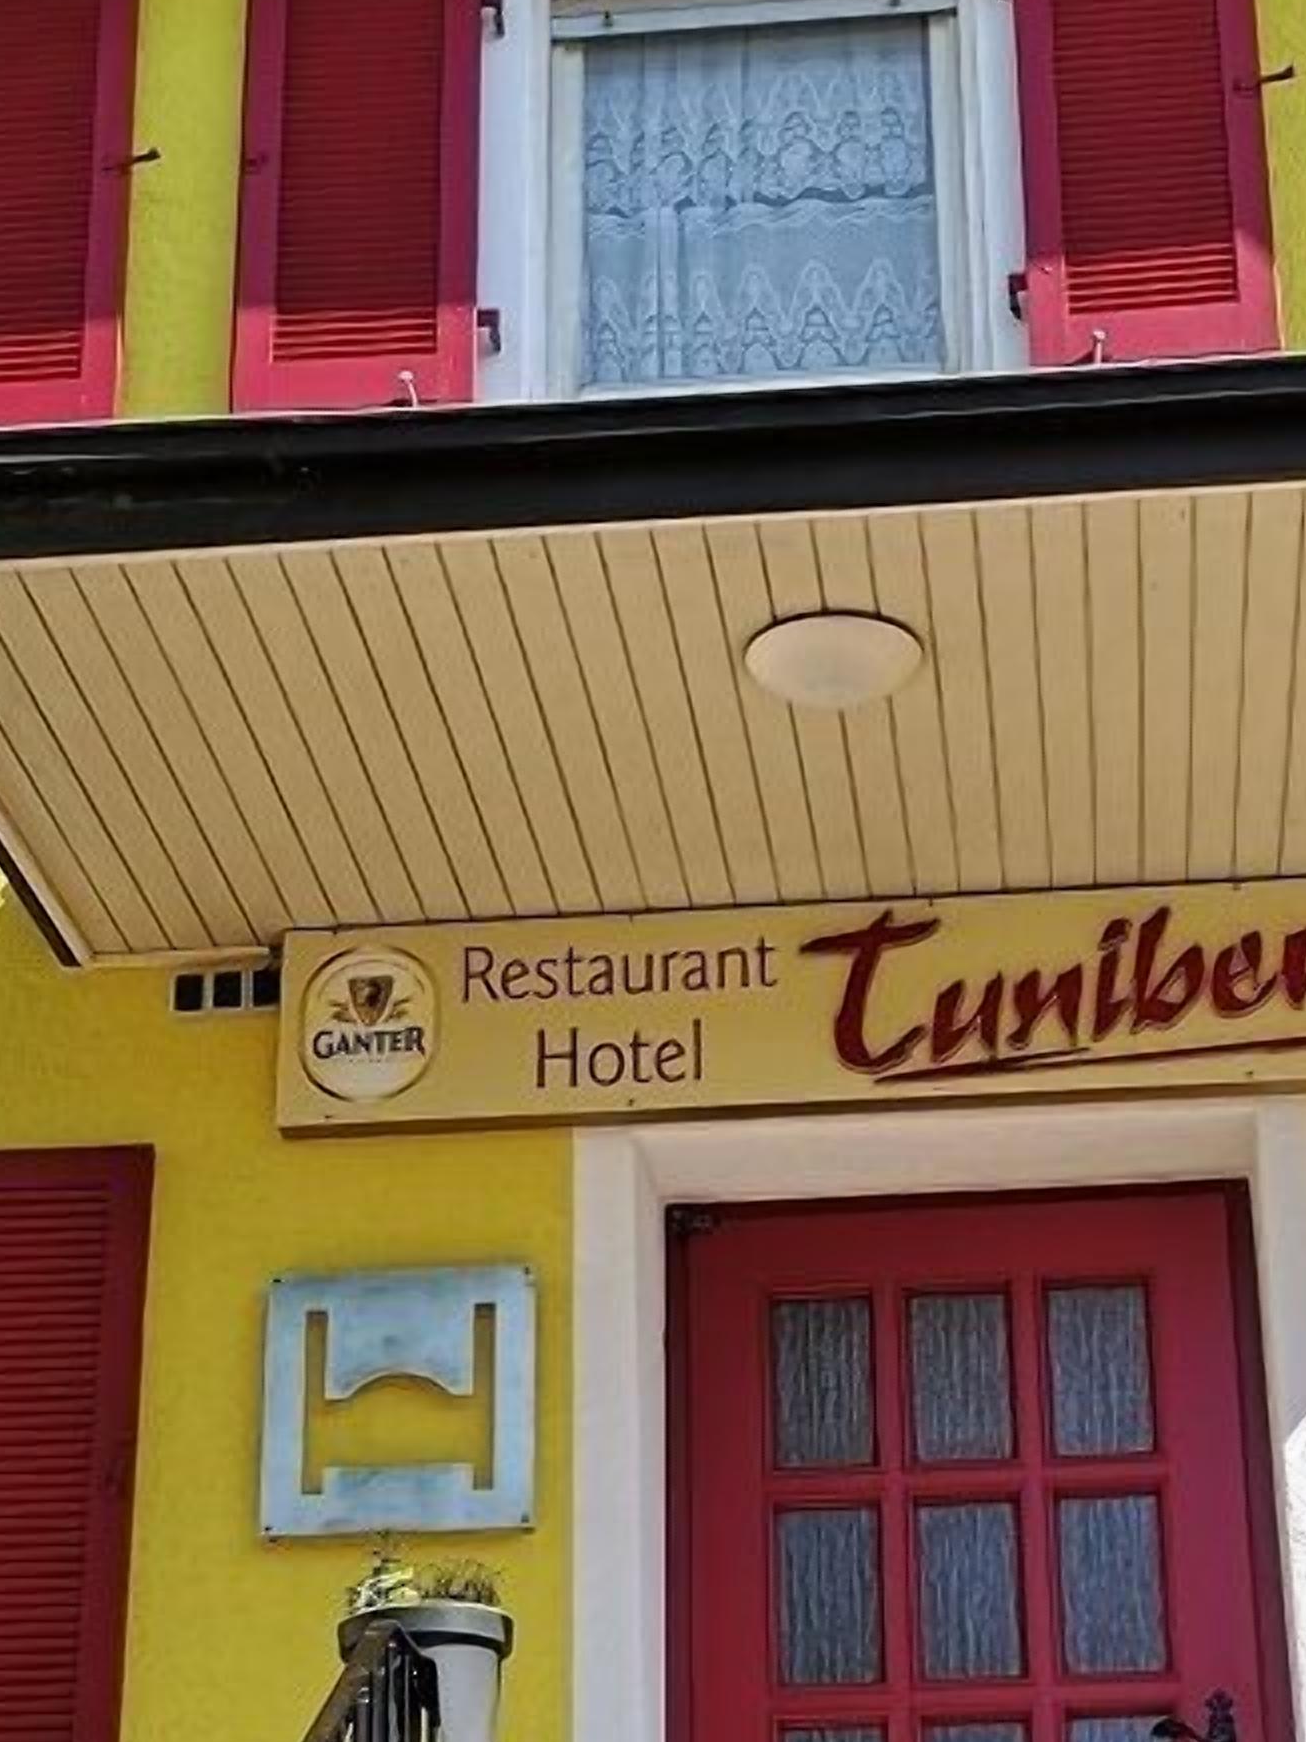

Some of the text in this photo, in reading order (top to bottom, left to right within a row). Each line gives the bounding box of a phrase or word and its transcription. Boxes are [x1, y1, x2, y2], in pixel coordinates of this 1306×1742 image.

[462, 936, 778, 1003] Restaurant
[313, 1026, 426, 1059] GANTER
[536, 1018, 702, 1088] Hotel
